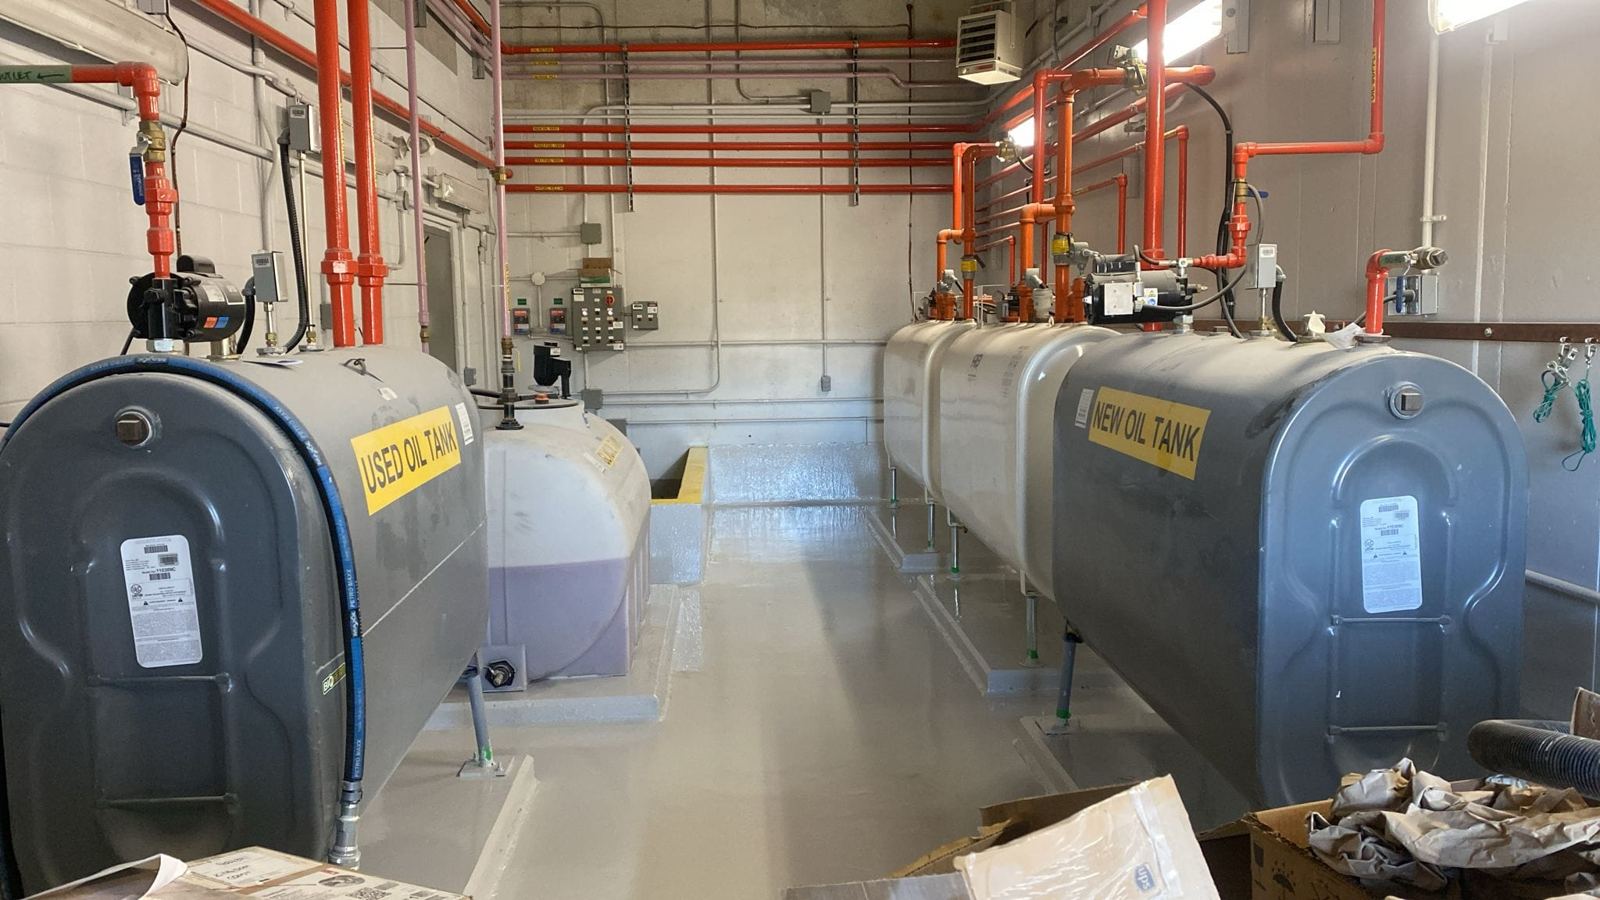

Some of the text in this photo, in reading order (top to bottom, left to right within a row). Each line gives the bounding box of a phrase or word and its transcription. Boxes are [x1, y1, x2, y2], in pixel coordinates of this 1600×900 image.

[0, 71, 32, 80] UTLET
[361, 444, 404, 494] USED
[404, 435, 427, 472] OIL
[424, 421, 457, 461] TANK
[1092, 401, 1125, 435] NEW
[1125, 409, 1146, 445] OIL
[1152, 416, 1201, 462] TANK
